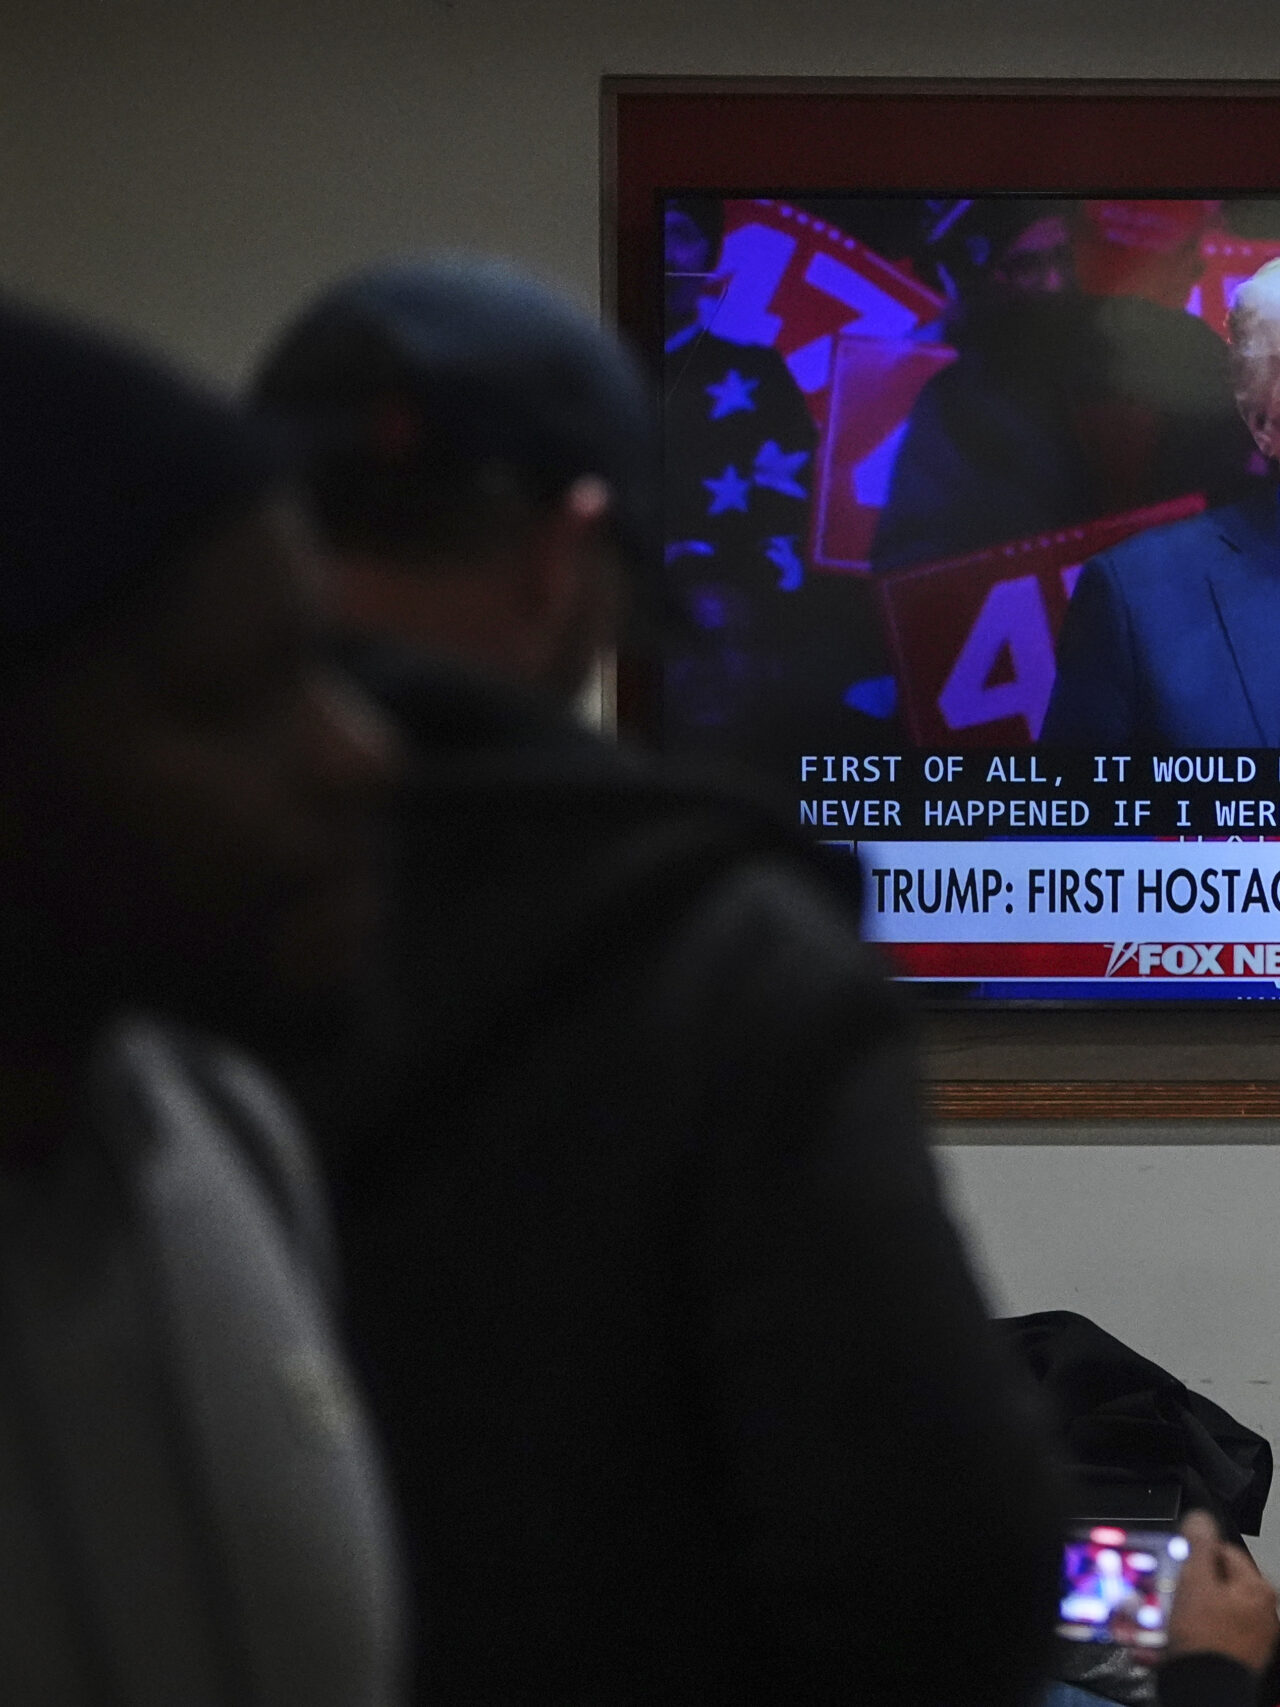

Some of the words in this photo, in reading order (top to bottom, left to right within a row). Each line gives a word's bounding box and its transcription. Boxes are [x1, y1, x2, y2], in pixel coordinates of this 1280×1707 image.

[801, 756, 902, 782] FIRST
[924, 756, 964, 783] OF
[986, 756, 1063, 787] ALL,
[1093, 756, 1132, 783] IT
[1153, 756, 1256, 783] WOULD
[800, 800, 902, 826] NEVER
[924, 800, 1090, 827] HAPPENED
[1113, 800, 1151, 827] IF
[1176, 800, 1192, 827] I
[872, 868, 1014, 914] TRUMP:
[1028, 868, 1125, 913] FIRST
[1138, 944, 1224, 975] FOX
